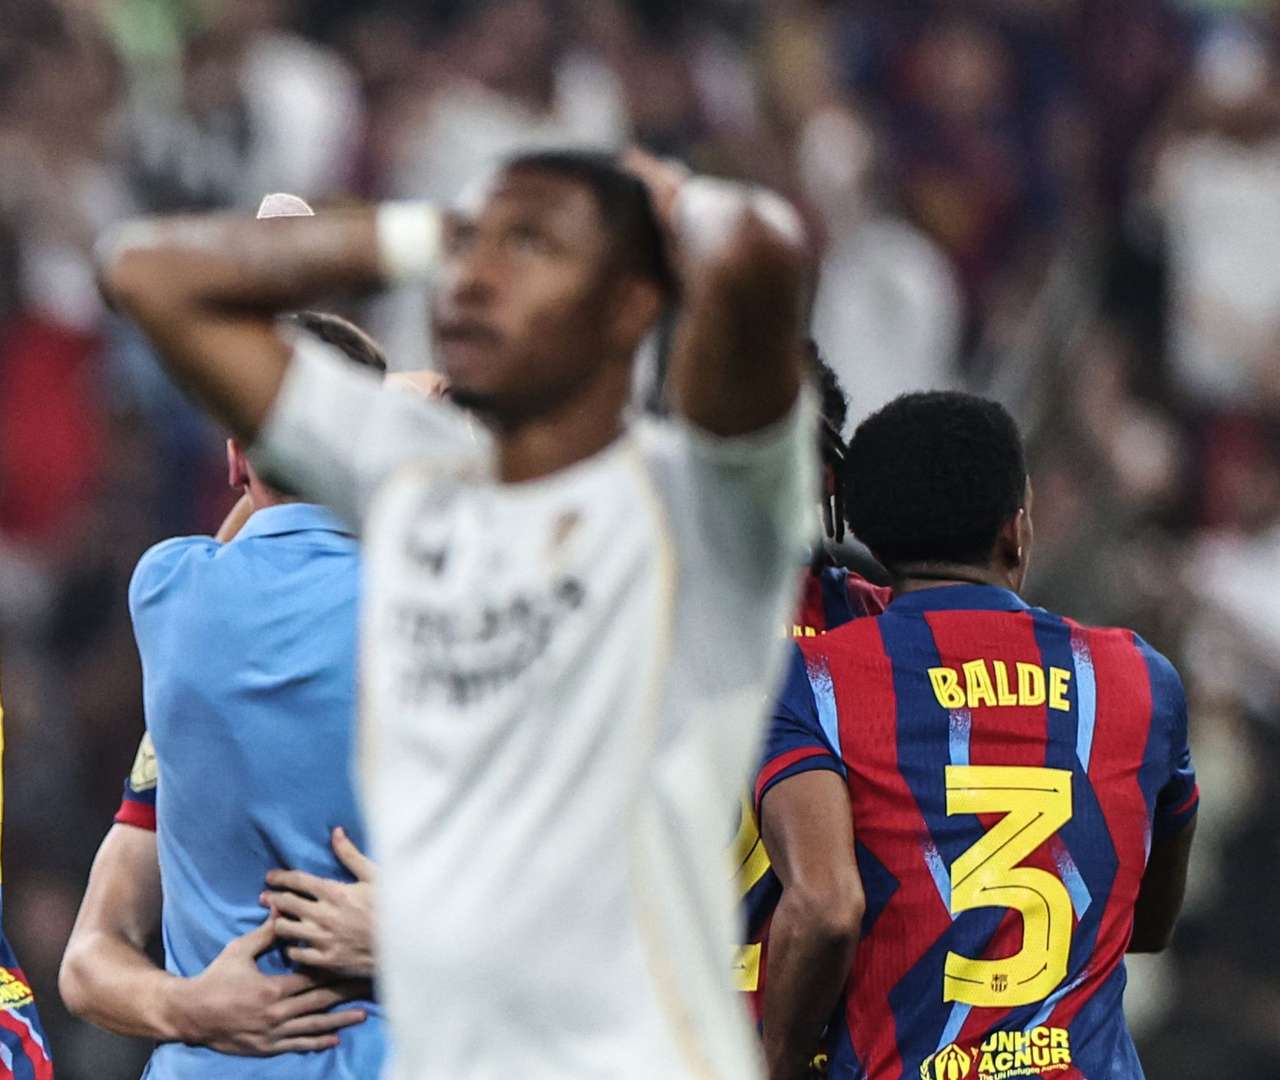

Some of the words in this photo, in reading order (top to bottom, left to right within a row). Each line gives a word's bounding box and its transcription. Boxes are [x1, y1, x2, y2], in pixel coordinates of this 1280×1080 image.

[927, 659, 1072, 711] BALDE
[943, 764, 1074, 1008] 3
[980, 1026, 1070, 1053] UNHCR
[977, 1047, 1072, 1074] ACNUR
